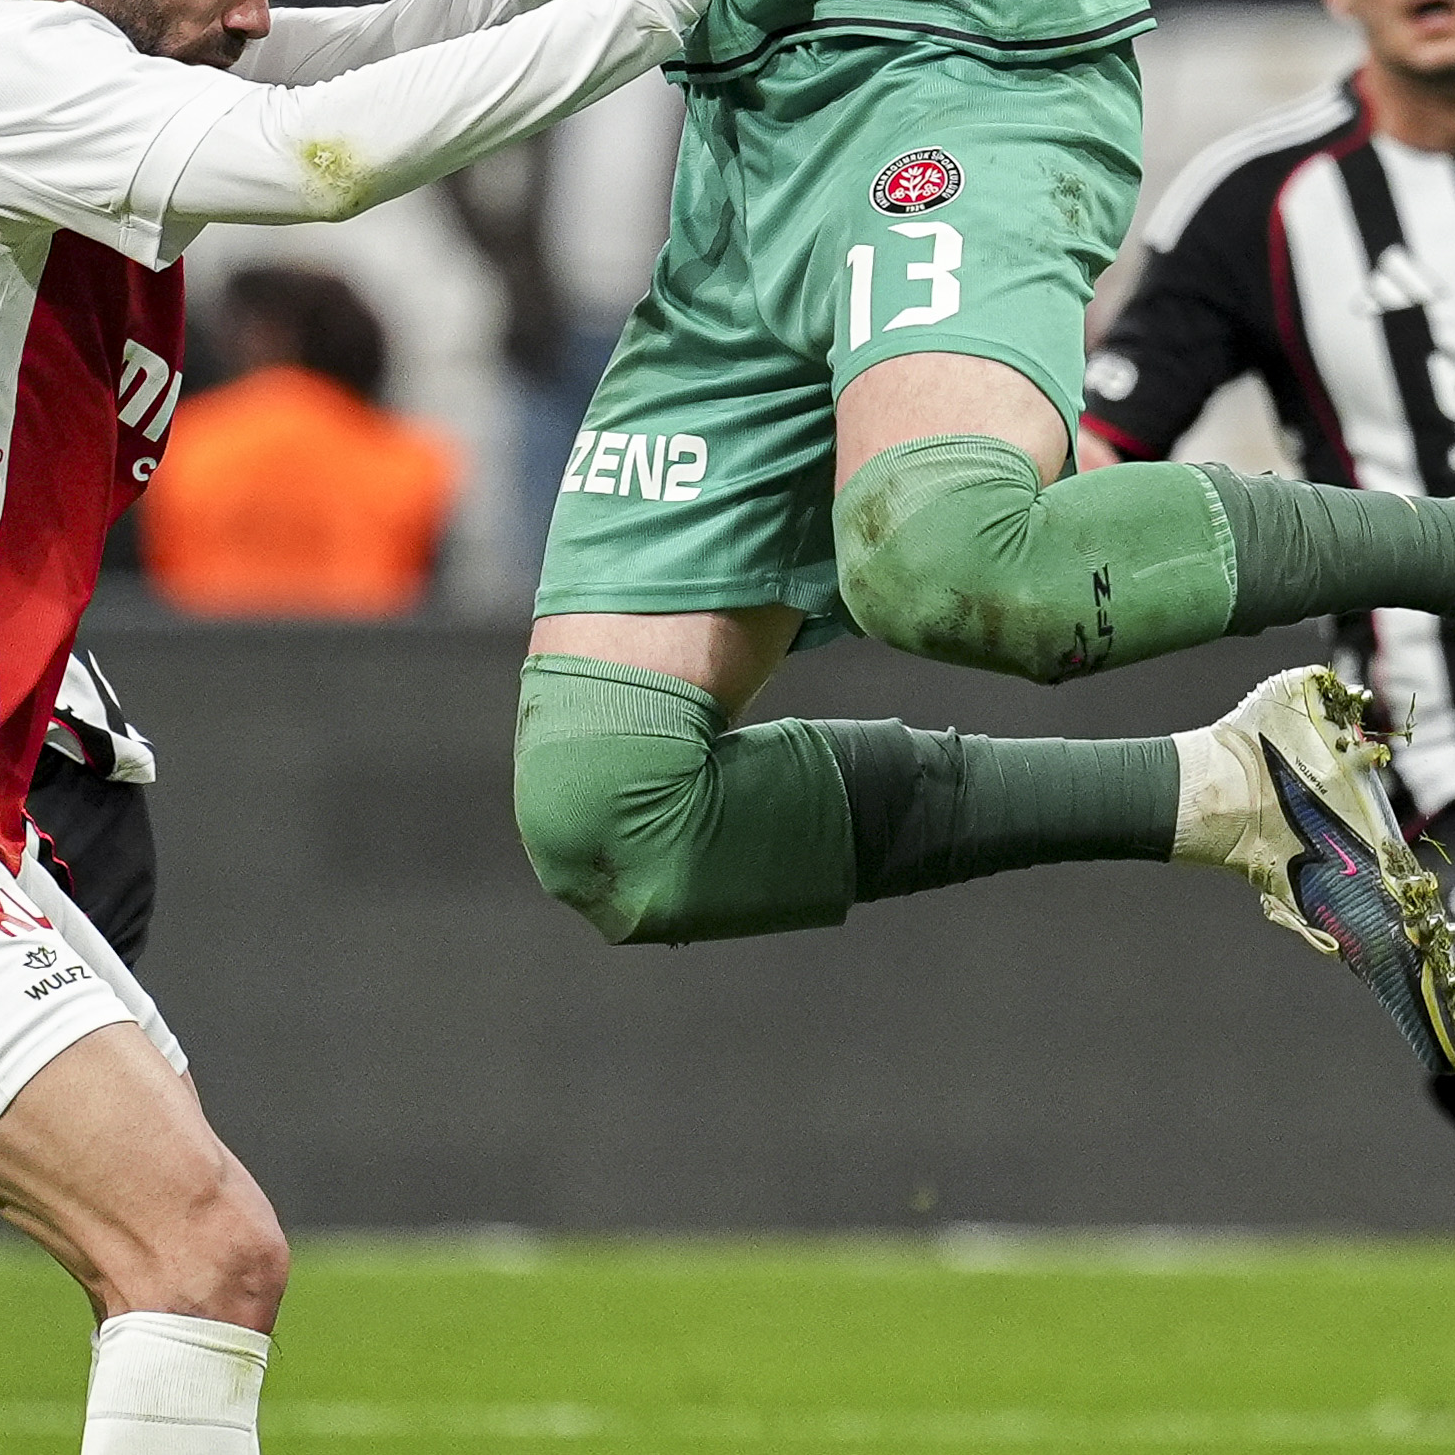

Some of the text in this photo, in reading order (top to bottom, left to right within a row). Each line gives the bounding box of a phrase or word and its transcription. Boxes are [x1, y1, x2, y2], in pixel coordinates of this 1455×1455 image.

[846, 220, 964, 352] 13
[560, 430, 709, 502] ZEN2
[23, 965, 92, 1001] WULFZ
